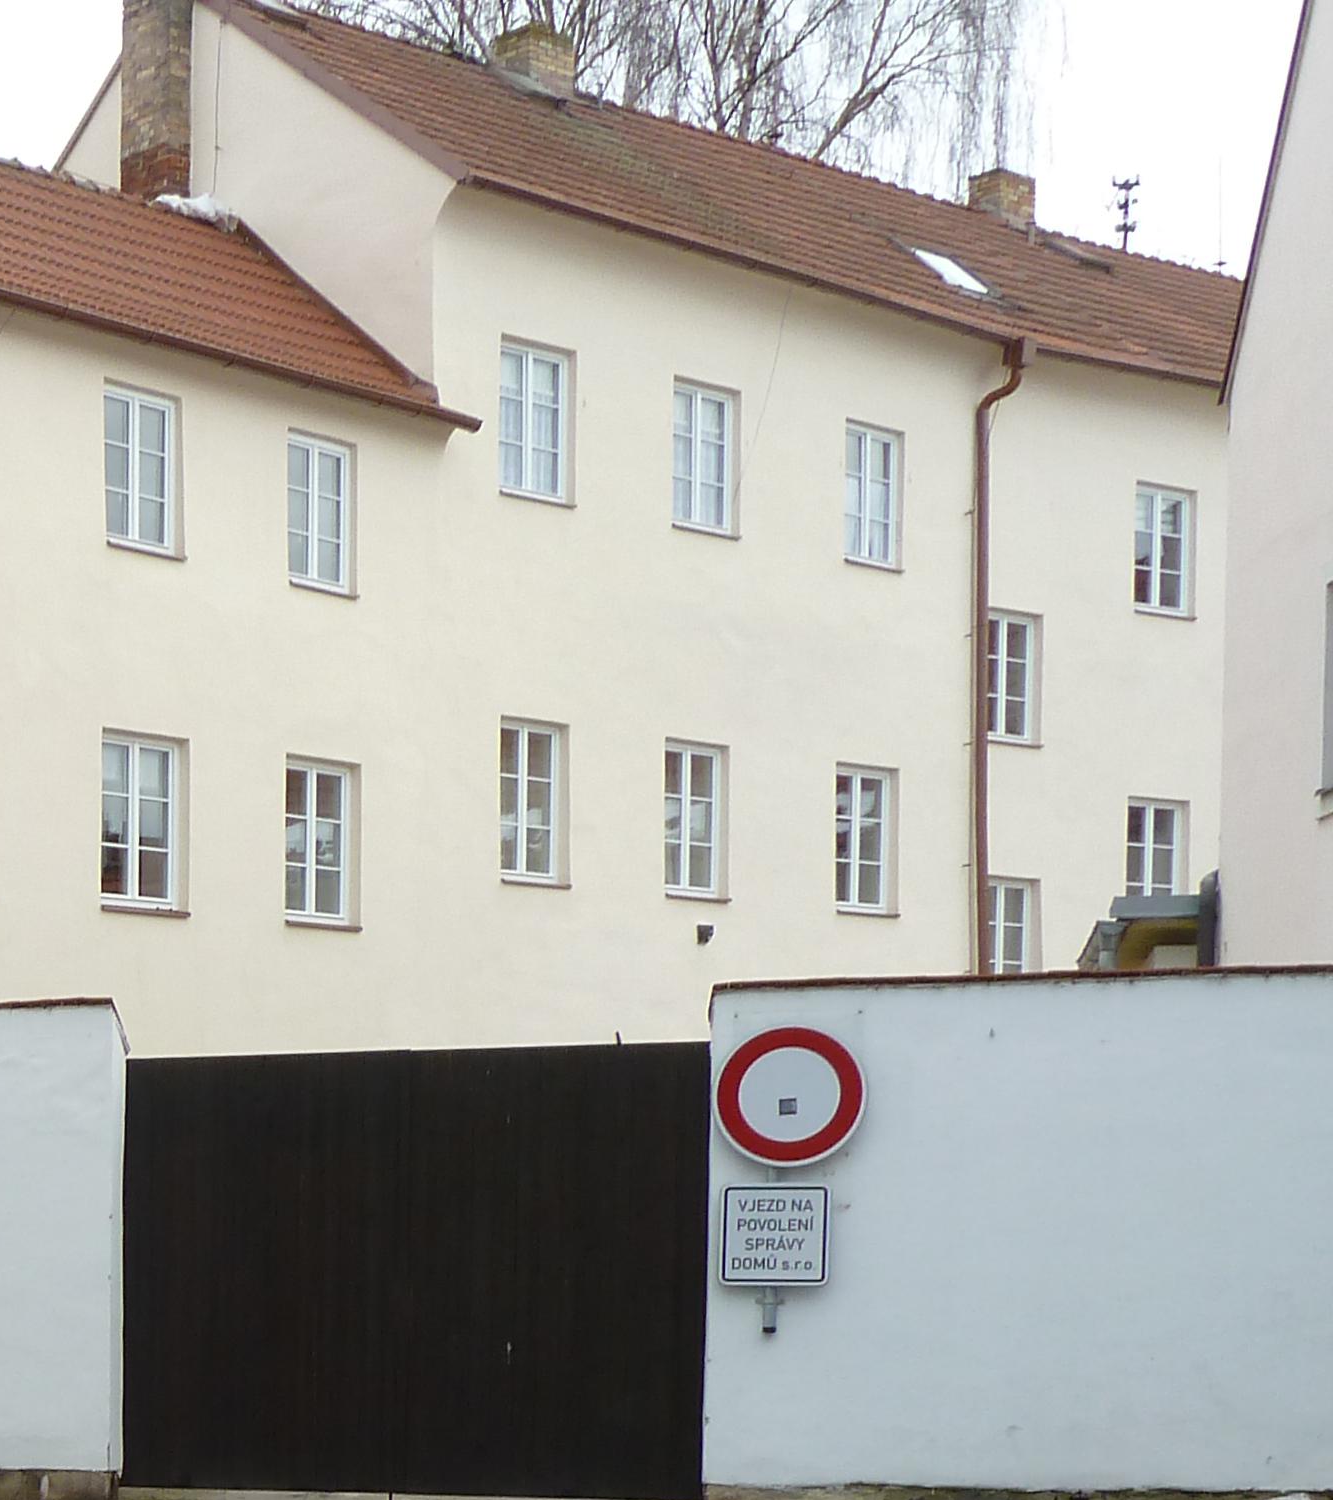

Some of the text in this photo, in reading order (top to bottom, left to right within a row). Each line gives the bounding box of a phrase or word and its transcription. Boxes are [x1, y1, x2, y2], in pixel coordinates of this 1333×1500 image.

[738, 1199, 813, 1212] VJEZD NA
[737, 1216, 814, 1231] POVOLENÍ
[744, 1236, 805, 1251] SPRÁVY
[732, 1255, 777, 1270] DOMŮ
